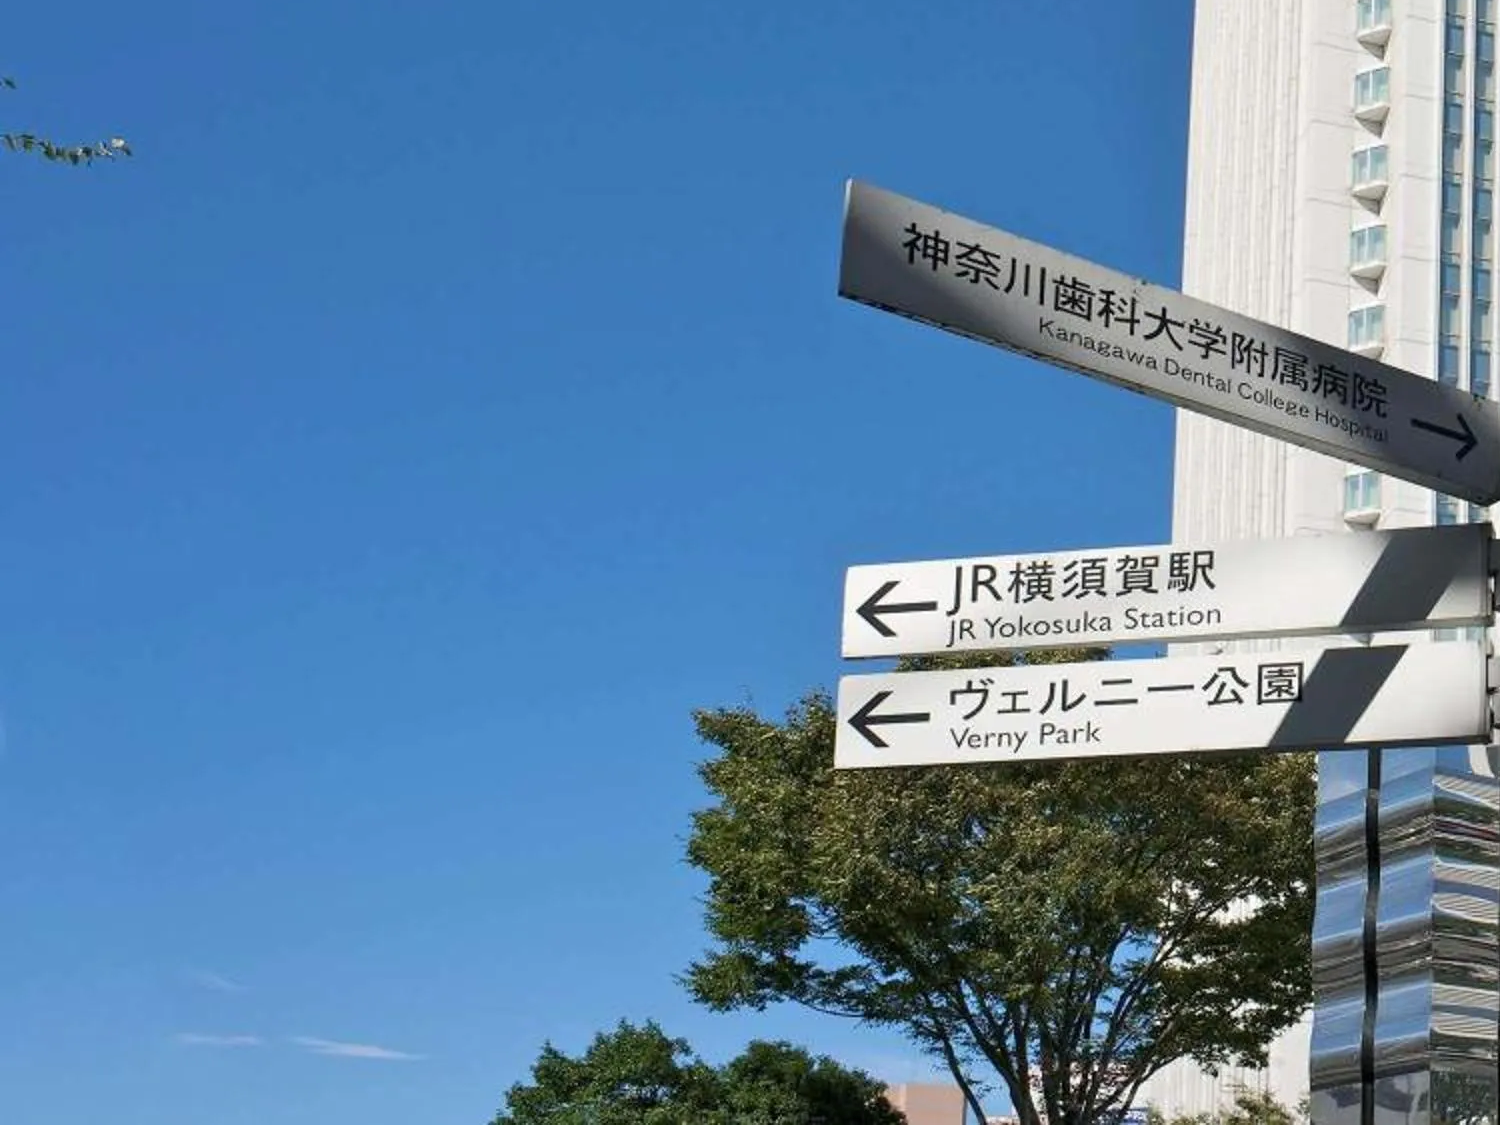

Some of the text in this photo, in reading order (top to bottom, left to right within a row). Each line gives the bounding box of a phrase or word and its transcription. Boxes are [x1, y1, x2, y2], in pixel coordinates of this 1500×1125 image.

[902, 222, 1388, 418] 神奈川歯科大学附属病院
[1038, 317, 1389, 443] Kanagawa Dental College Hospital
[945, 549, 1216, 617] JR横須賀駅
[945, 605, 1221, 648] JR Yokosuka Station
[949, 661, 1304, 721] ヴェルニー公園
[950, 721, 1101, 753] Verny Park
